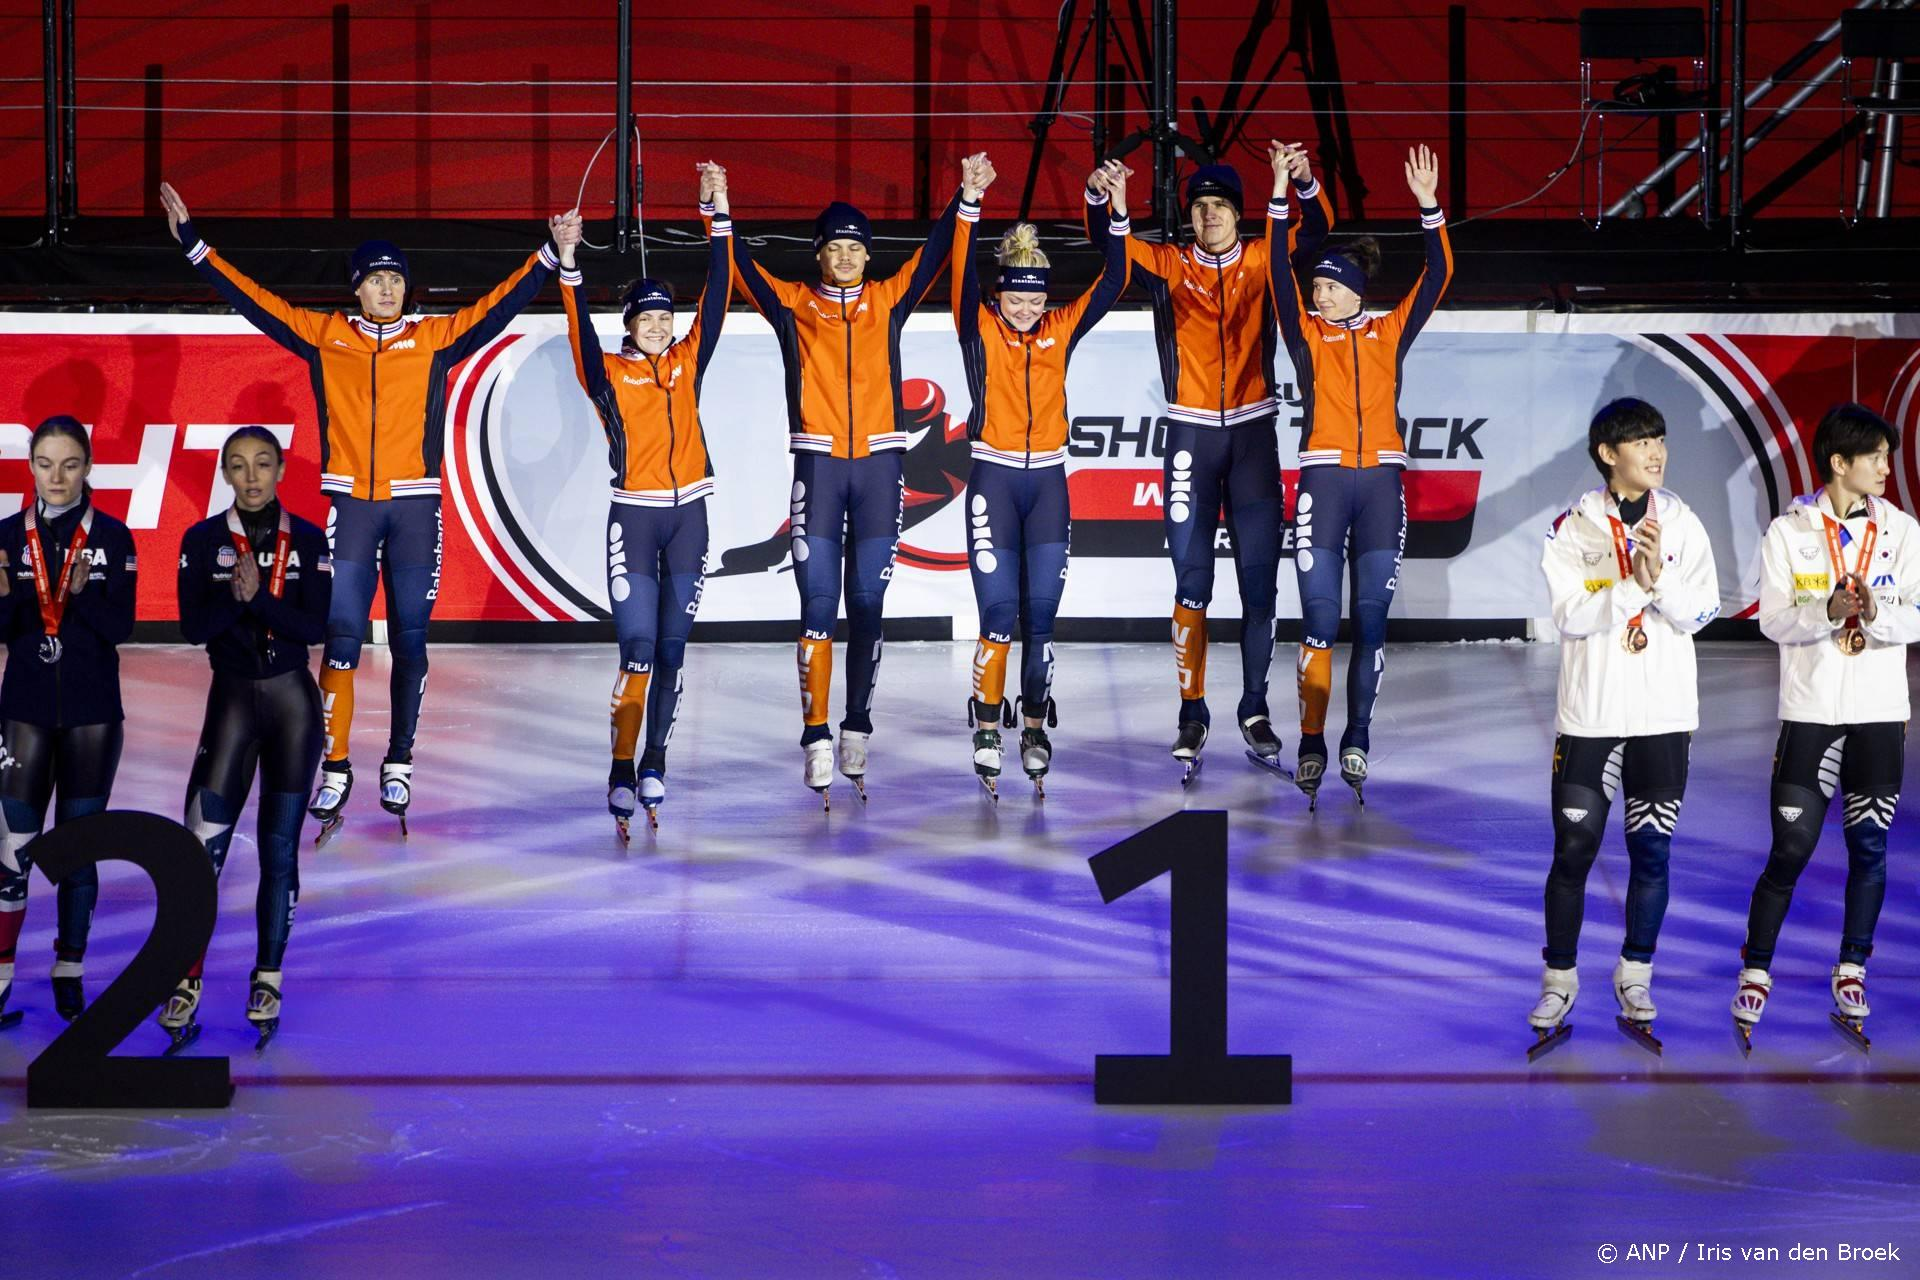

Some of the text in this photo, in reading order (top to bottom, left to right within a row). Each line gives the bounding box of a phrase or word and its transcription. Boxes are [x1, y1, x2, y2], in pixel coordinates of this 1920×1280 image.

[258, 550, 301, 567] UA
[1182, 598, 1204, 609] FILA
[805, 629, 828, 640] FILA
[988, 632, 1011, 642] FILA
[1306, 636, 1328, 648] FILA
[328, 659, 351, 670] FILA
[627, 661, 649, 672] FILA
[27, 809, 231, 1109] 2
[1088, 810, 1292, 1105] 1
